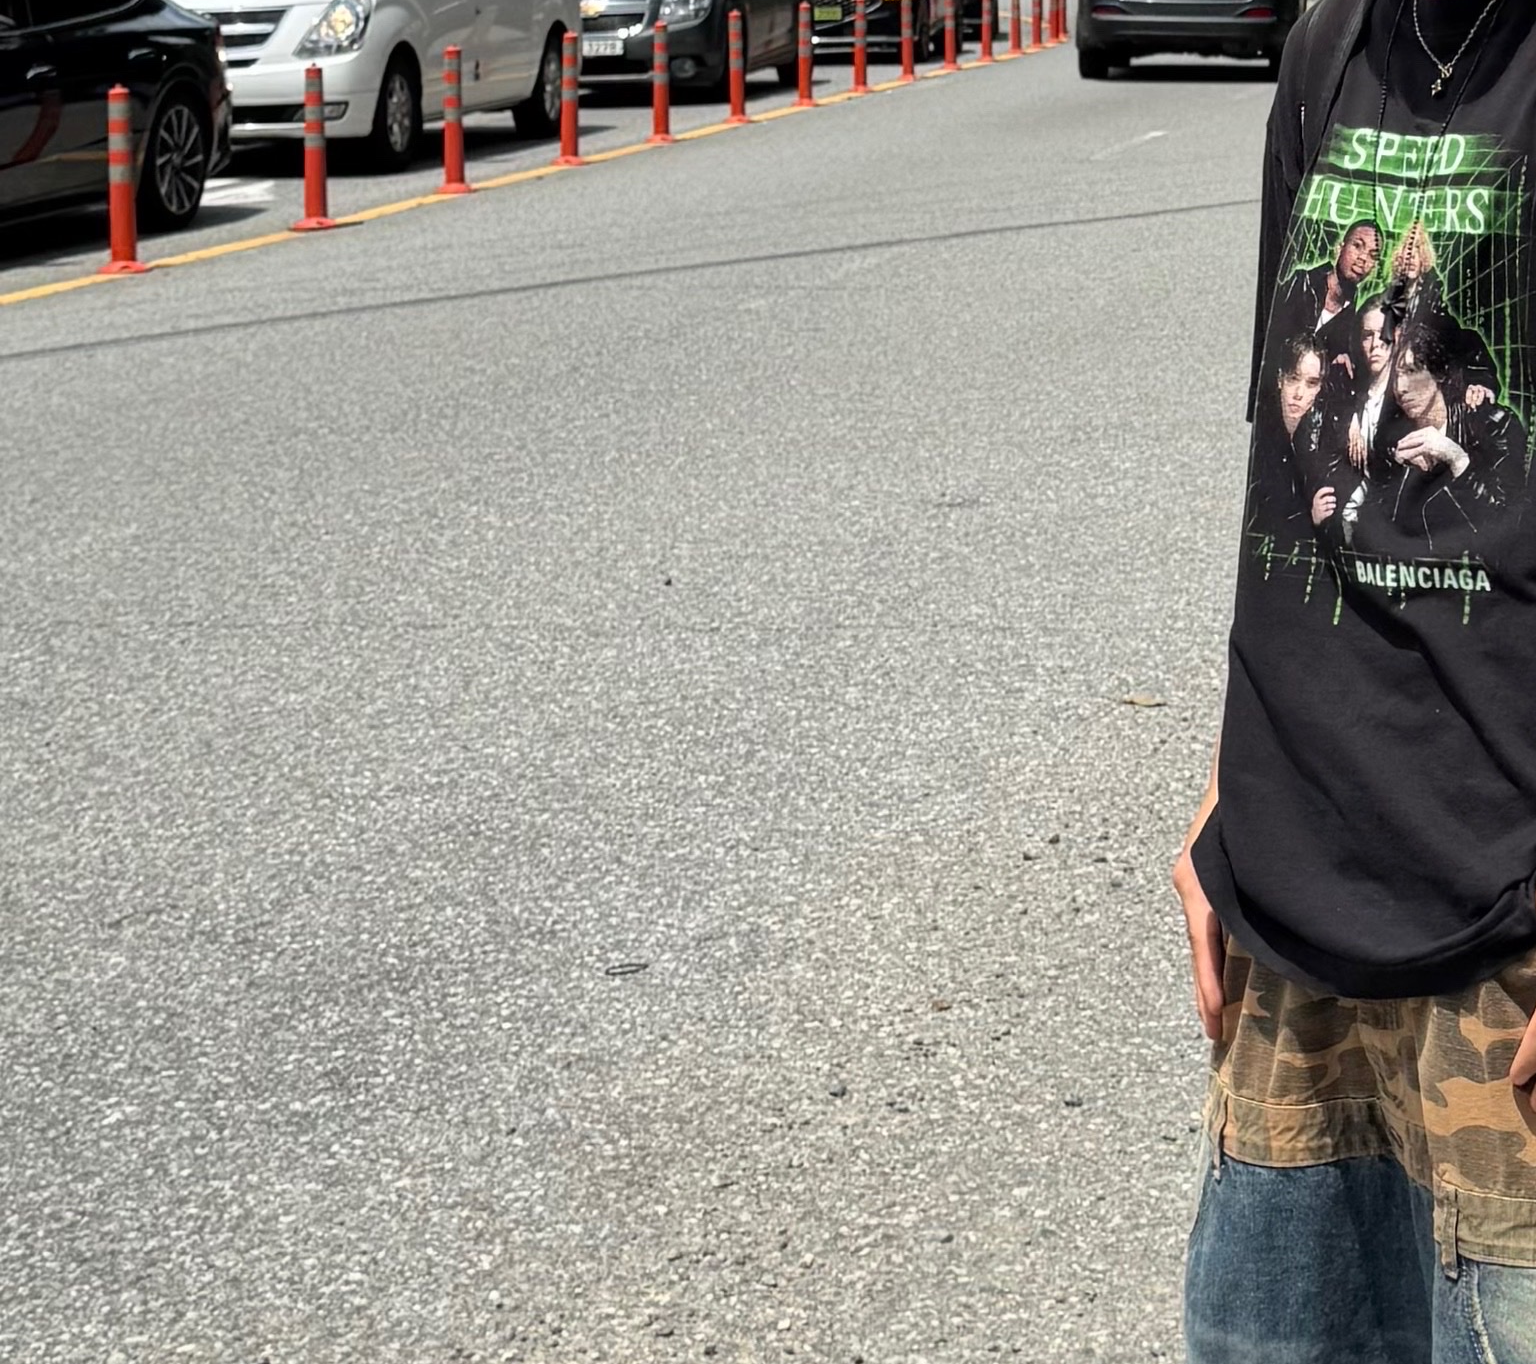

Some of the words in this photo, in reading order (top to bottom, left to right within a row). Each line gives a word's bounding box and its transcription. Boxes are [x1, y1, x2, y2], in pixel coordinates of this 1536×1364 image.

[1344, 127, 1466, 179] SPEED
[1303, 175, 1490, 235] HUNTERS
[1354, 560, 1492, 592] BALENCIAGA
